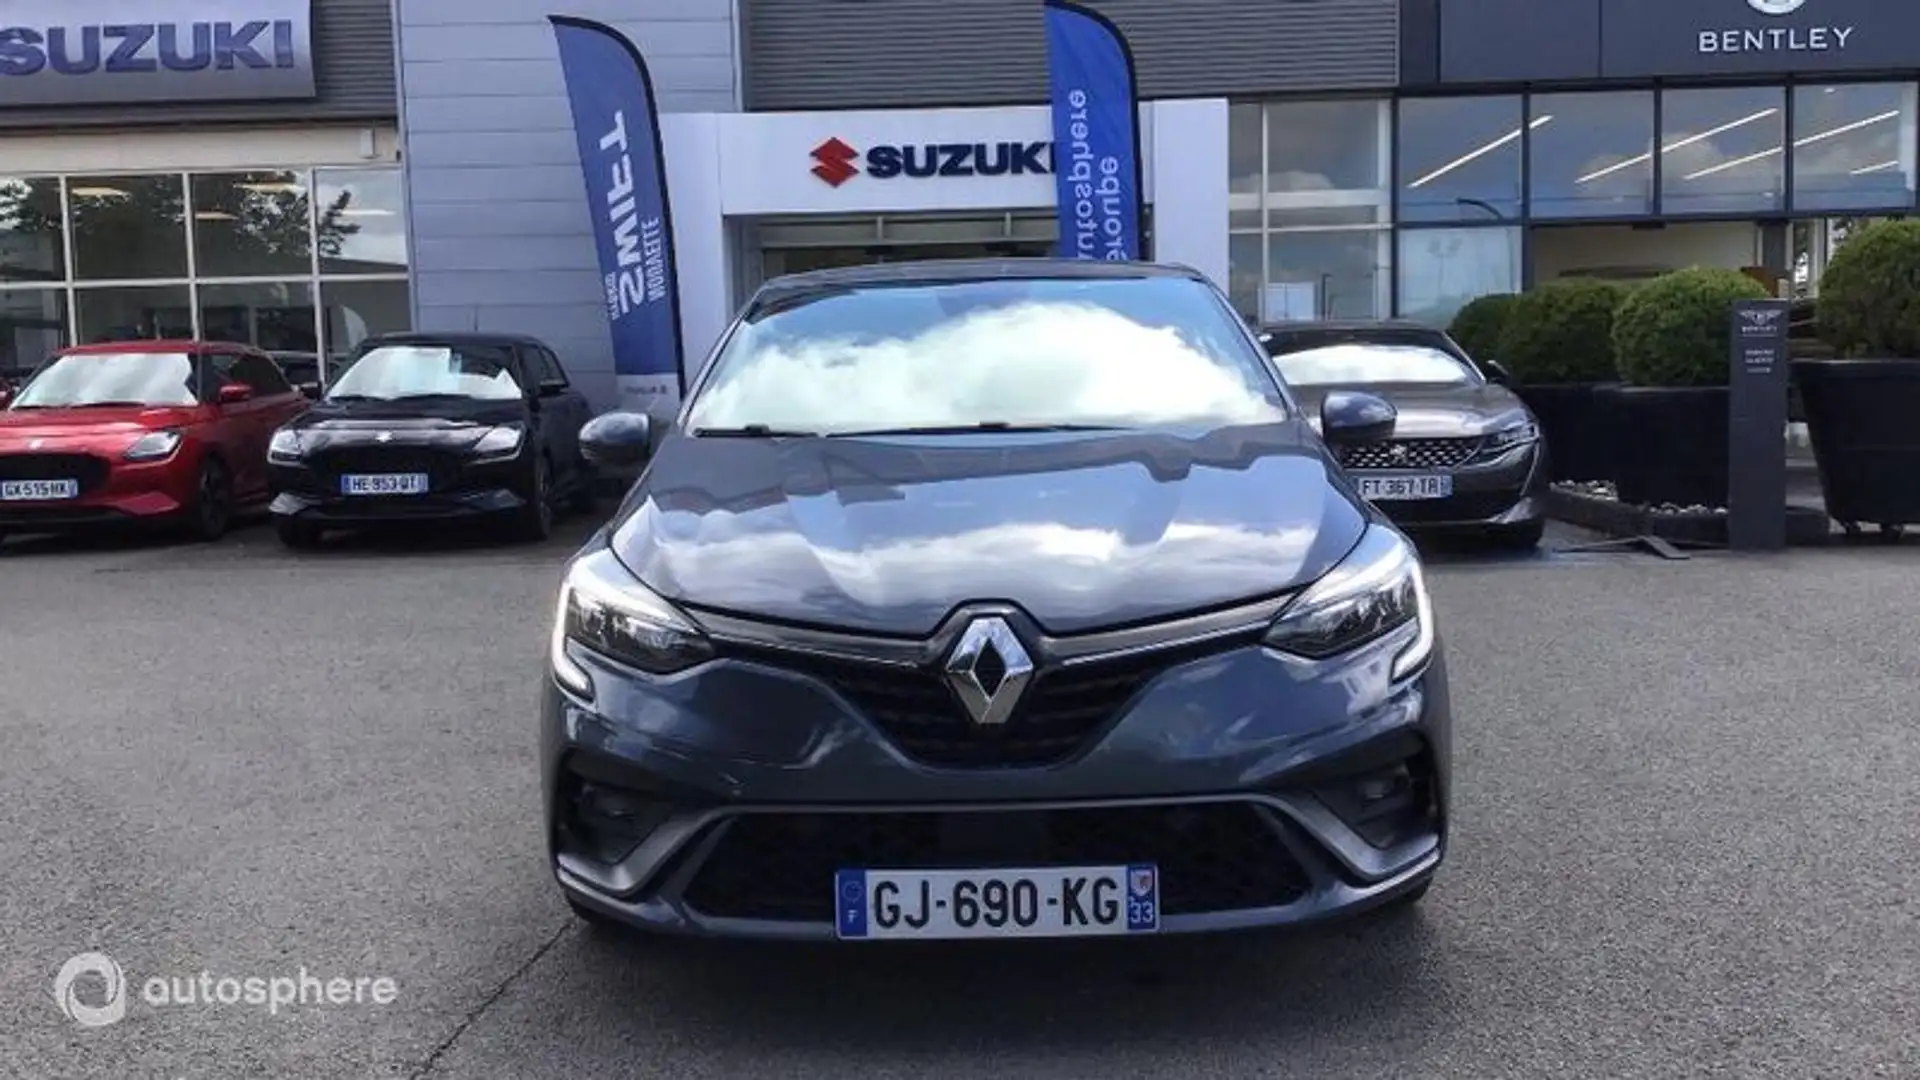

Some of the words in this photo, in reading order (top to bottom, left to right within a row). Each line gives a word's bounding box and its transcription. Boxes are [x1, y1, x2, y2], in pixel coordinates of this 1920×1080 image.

[0, 20, 294, 75] SUZUKI
[1699, 27, 1853, 52] BENTLEY
[874, 877, 1119, 929] GJ-690-KG
[1128, 901, 1153, 924] 33
[847, 910, 859, 923] F
